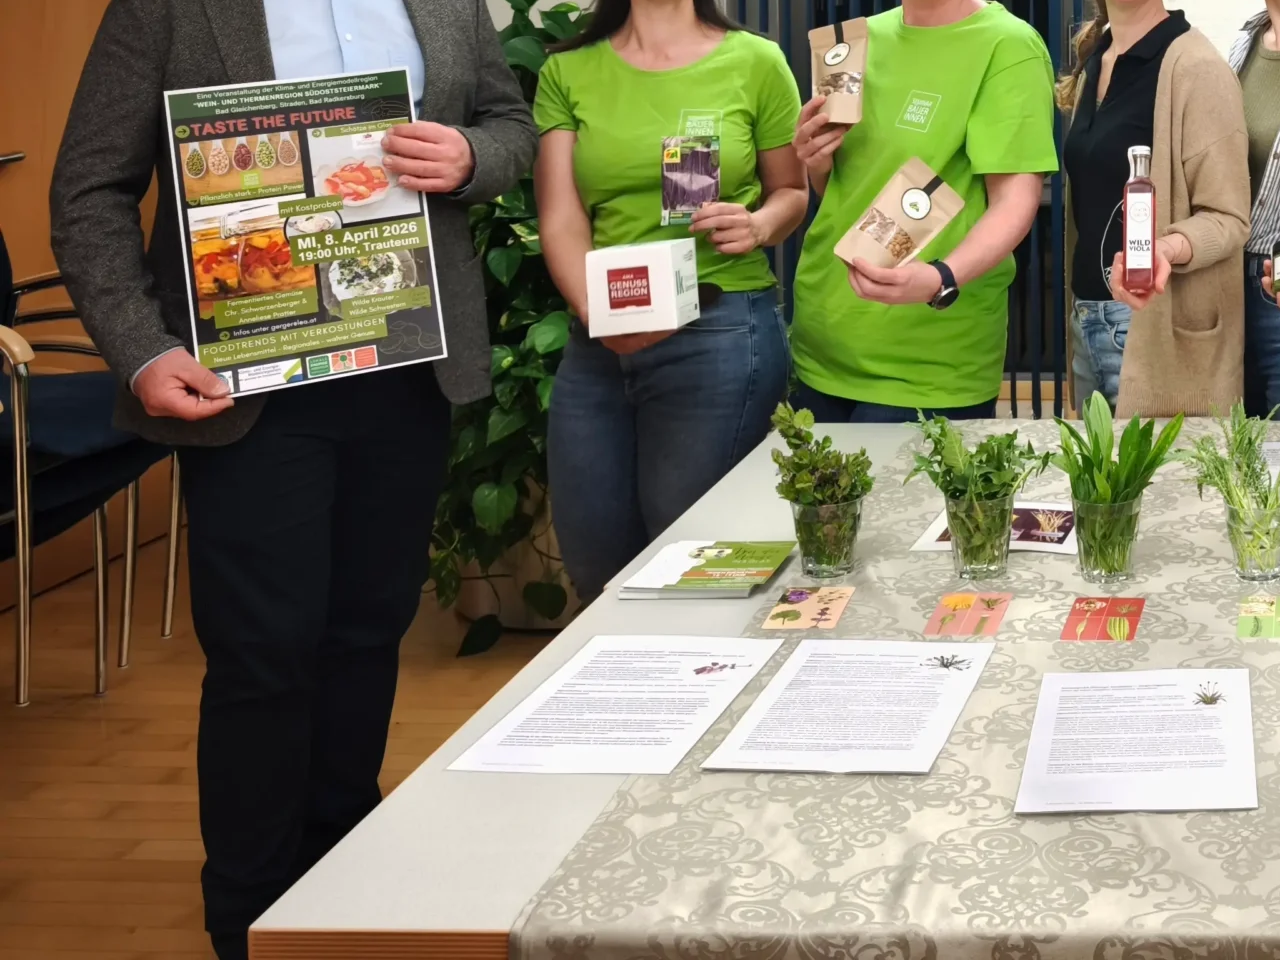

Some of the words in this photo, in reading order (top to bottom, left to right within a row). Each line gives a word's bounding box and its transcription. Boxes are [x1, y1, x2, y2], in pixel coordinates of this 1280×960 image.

[212, 87, 260, 99] Veranstaltung
[274, 83, 295, 91] Klima-
[311, 75, 378, 88] Energiemodellregion
[230, 102, 278, 114] Gleichenberg,
[279, 99, 307, 108] Straden,
[323, 93, 365, 103] Radkersburg
[239, 91, 303, 103] THERMENREGION
[189, 117, 248, 137] TASTE
[251, 113, 286, 130] THE
[289, 105, 356, 125] FUTURE
[199, 191, 233, 202] Pflanzlich
[234, 189, 251, 197] stark
[258, 185, 281, 194] Protein
[283, 182, 304, 190] Power
[279, 206, 294, 214] mit
[295, 199, 343, 213] Kostproben
[296, 236, 321, 252] MI,
[324, 233, 338, 245] 8.
[341, 226, 378, 245] April
[381, 221, 417, 237] 2026
[298, 248, 330, 261] 19:00
[334, 244, 361, 257] Uhr,
[362, 234, 419, 251] Trauteum
[610, 278, 647, 290] GENUSS
[611, 287, 648, 299] REGION
[226, 293, 274, 307] Fermentiertes
[274, 288, 303, 298] Gemüse
[351, 298, 370, 306] Wilde
[224, 309, 239, 317] Chr.
[240, 299, 300, 315] Schwarzenberger
[349, 308, 367, 316] Wilde
[368, 301, 406, 312] Schwestern
[202, 336, 276, 355] FOODTRENDS
[280, 332, 298, 342] MIT
[301, 317, 385, 338] VERKOSTUNGEN
[232, 327, 250, 336] Infos
[251, 325, 269, 333] unter
[213, 355, 232, 363] Neue
[232, 346, 276, 360] Lebensmittel
[282, 339, 319, 352] Regionales
[326, 334, 349, 342] wahrer
